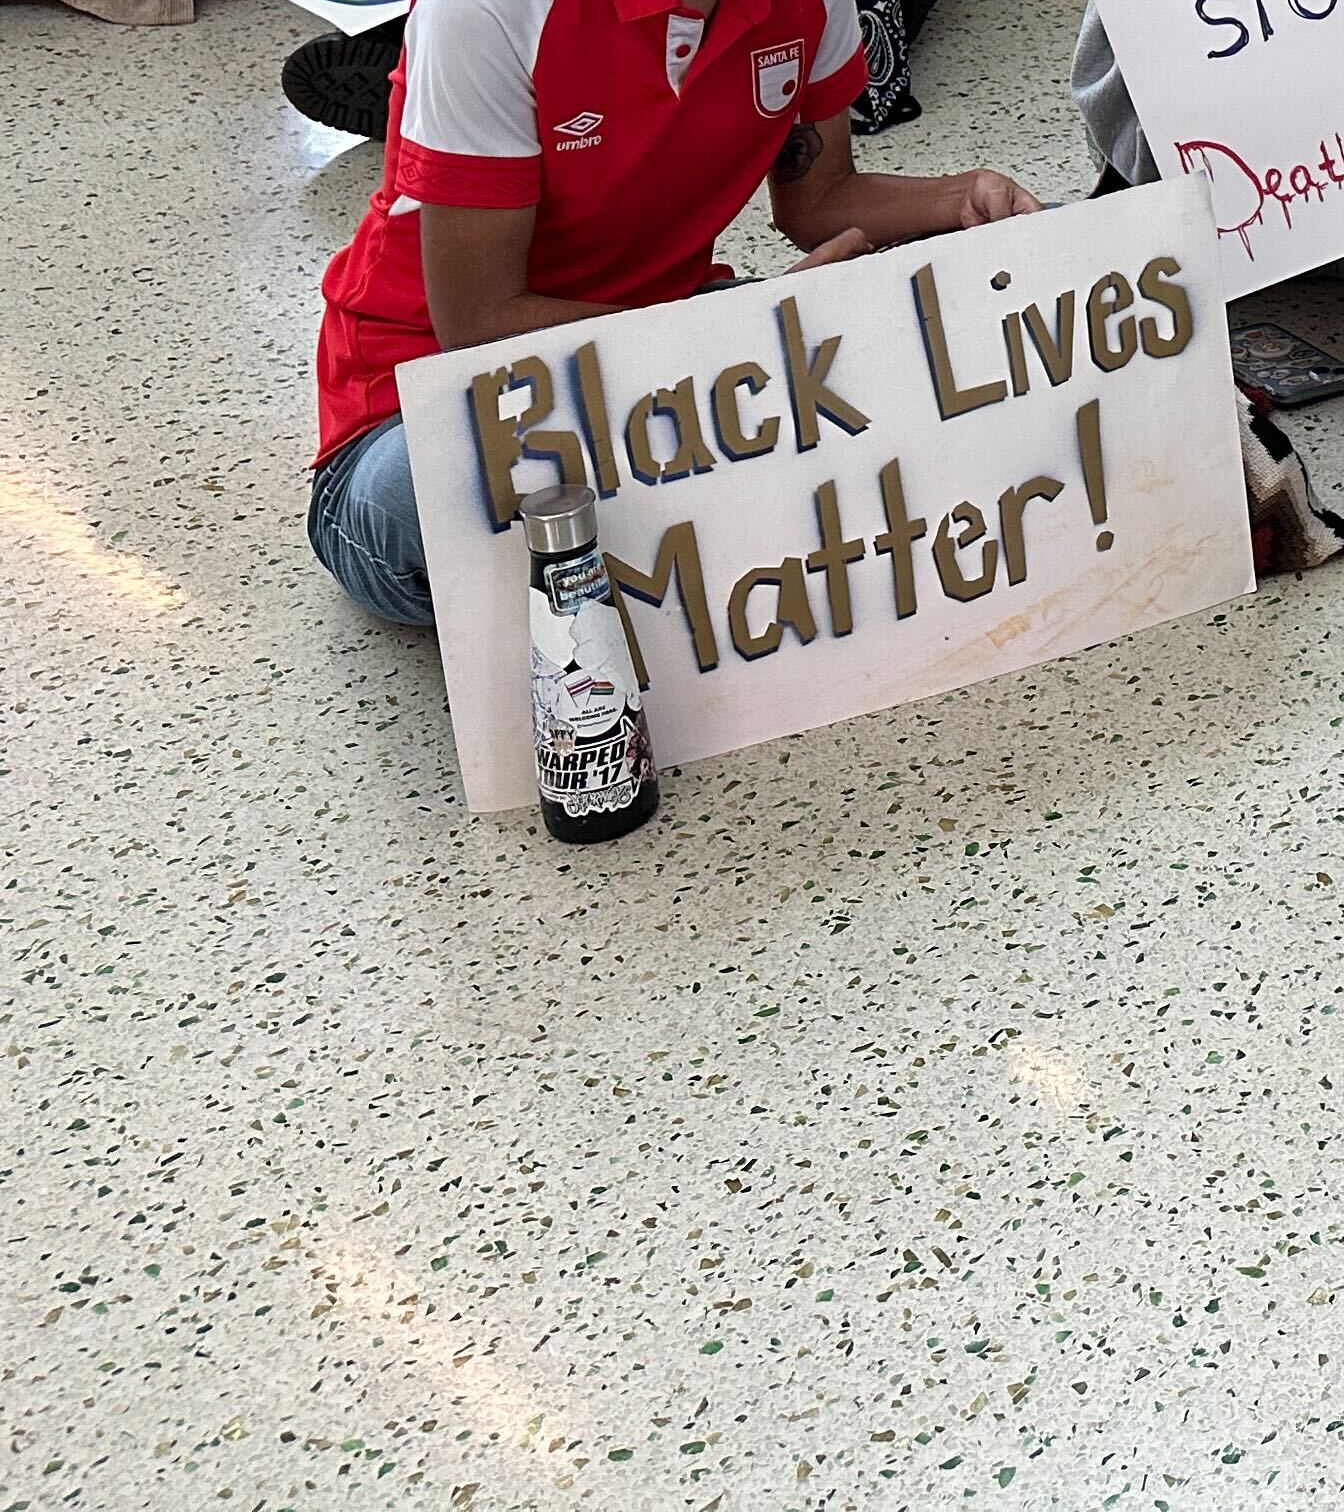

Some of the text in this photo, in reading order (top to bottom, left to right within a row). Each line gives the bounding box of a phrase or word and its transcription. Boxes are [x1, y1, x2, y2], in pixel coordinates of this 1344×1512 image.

[757, 45, 800, 68] SANTA FE
[556, 134, 602, 152] umbro
[467, 254, 1195, 534] Black Lives
[603, 397, 1116, 691] Matter!
[540, 739, 626, 772] WARPED
[541, 761, 623, 789] TOUR '17
